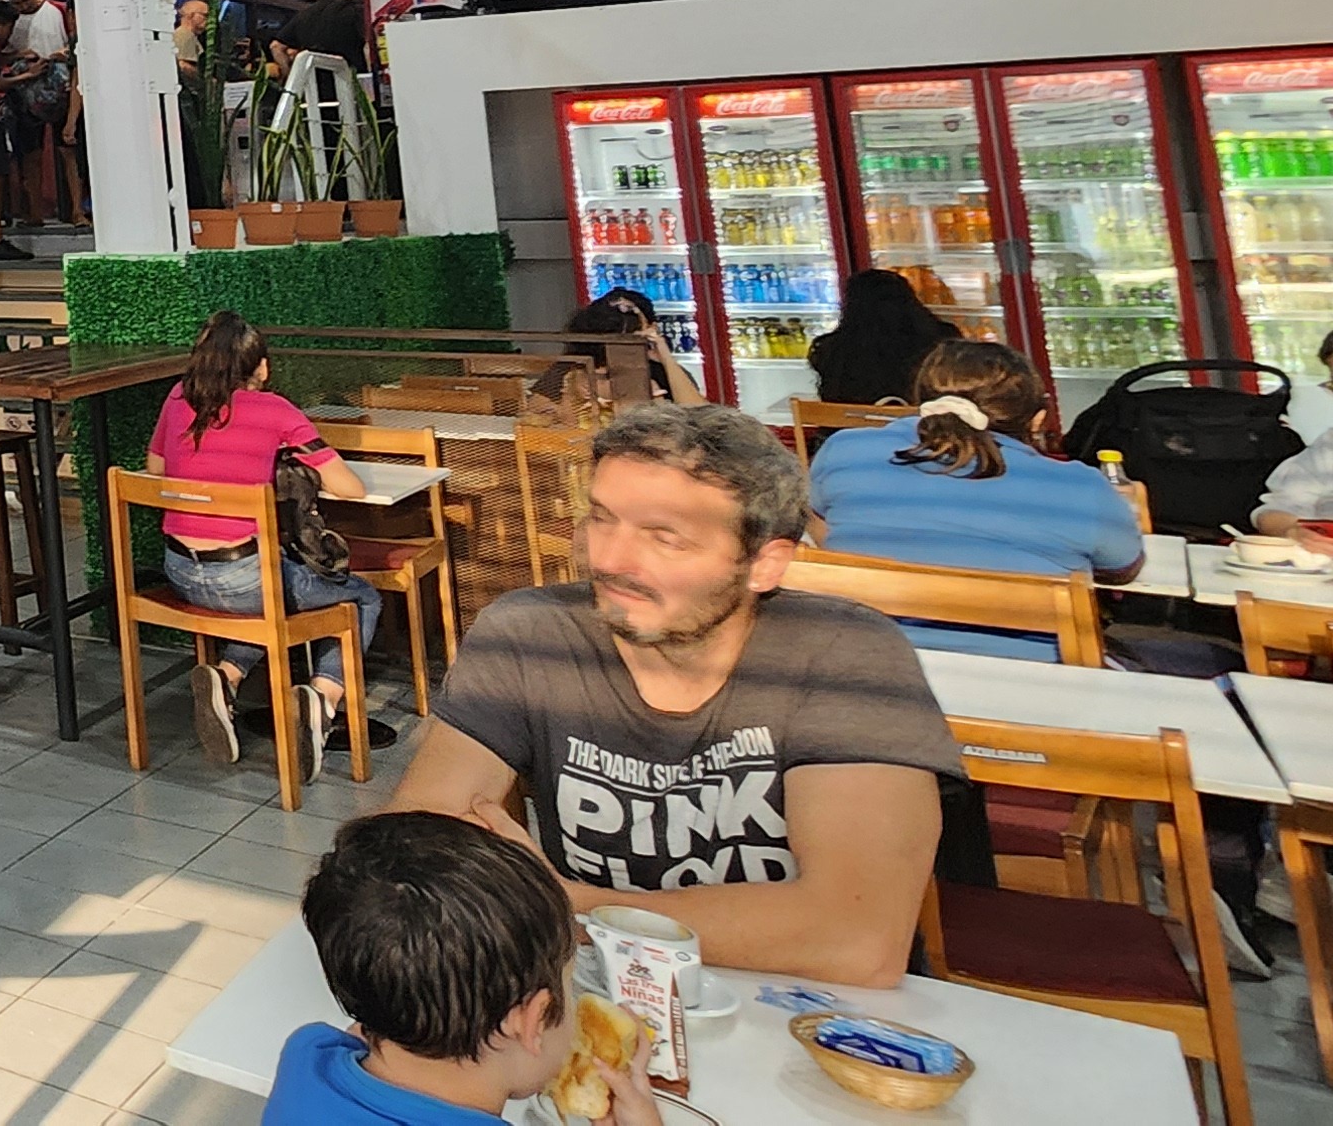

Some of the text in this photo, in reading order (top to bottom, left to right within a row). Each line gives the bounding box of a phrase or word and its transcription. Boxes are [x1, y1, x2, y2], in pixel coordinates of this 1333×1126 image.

[590, 103, 653, 121] Coca-Cola
[716, 93, 785, 115] Coca-Cola
[567, 736, 600, 771] THE
[600, 749, 651, 787] DARK
[556, 770, 787, 858] PINK
[621, 986, 665, 1006] Niñas
